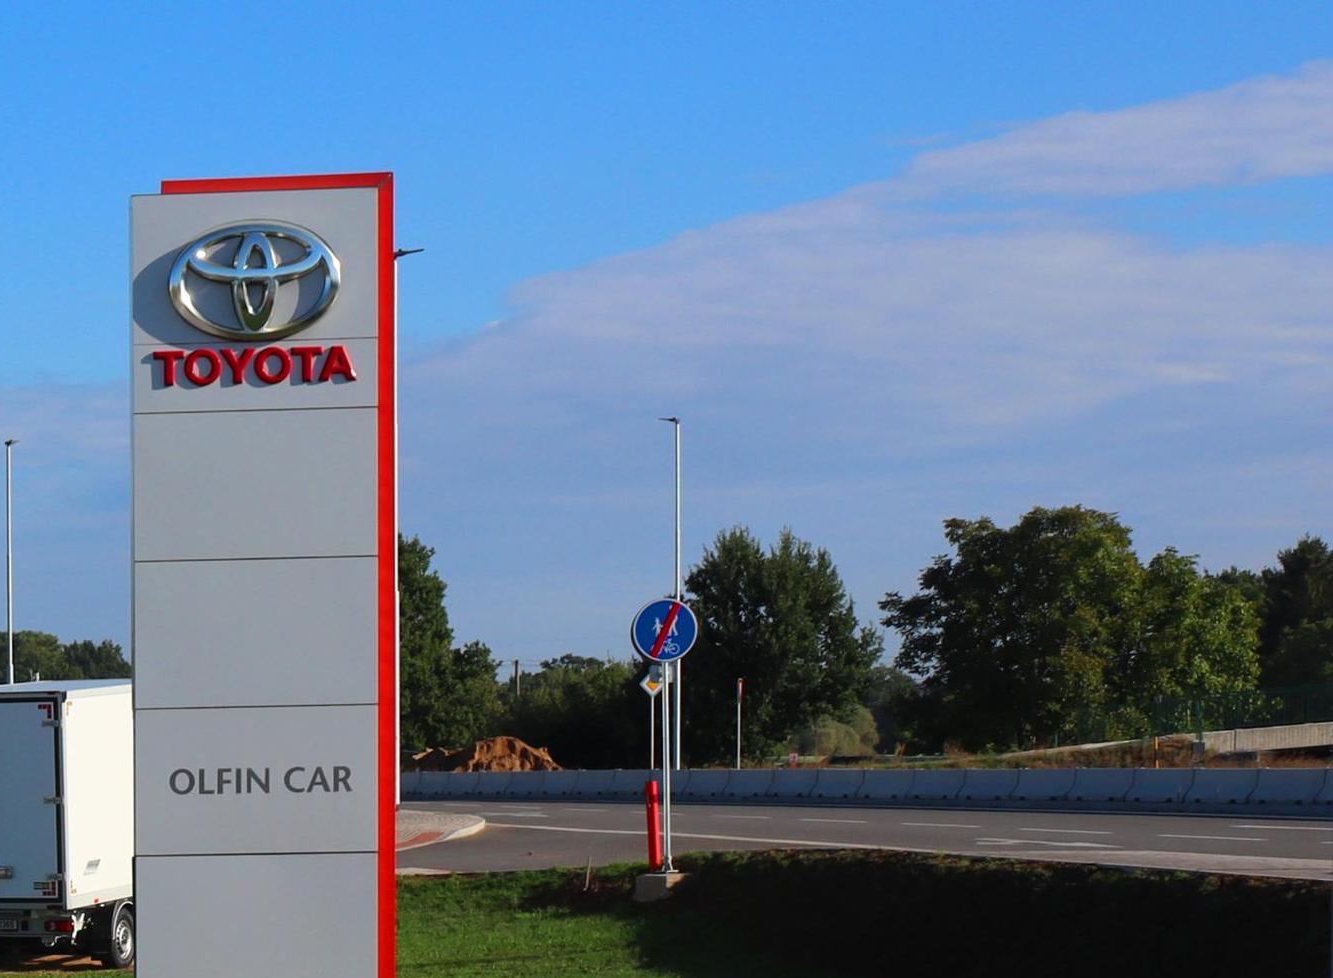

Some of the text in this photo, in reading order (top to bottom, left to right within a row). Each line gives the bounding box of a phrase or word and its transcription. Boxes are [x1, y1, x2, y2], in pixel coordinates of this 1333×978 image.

[152, 345, 357, 387] TOYOTA
[169, 765, 353, 795] OLFIN CAR
